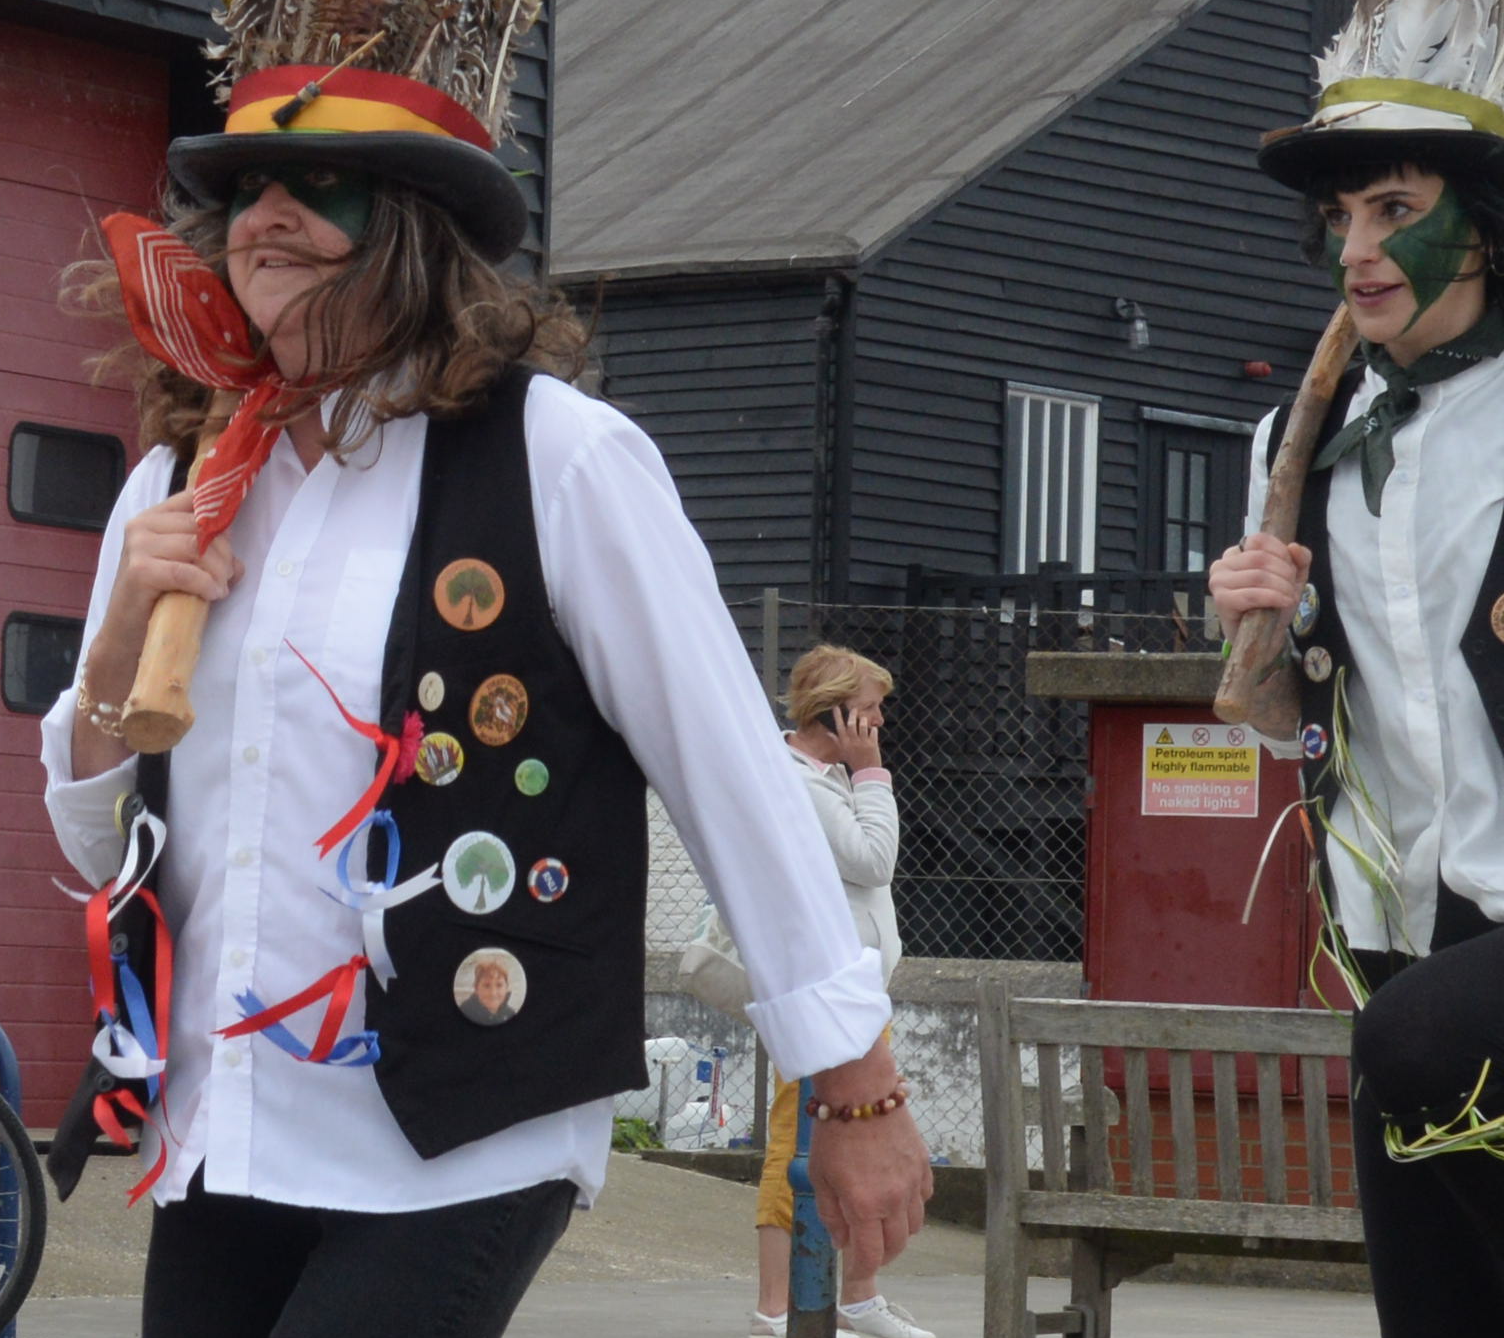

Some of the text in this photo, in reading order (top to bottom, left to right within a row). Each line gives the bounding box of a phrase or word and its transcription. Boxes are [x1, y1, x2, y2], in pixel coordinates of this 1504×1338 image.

[1155, 748, 1247, 762] Petroleum spirit
[1151, 762, 1250, 773] Highly flammable
[1151, 782, 1249, 797] No smoking or
[1159, 796, 1240, 810] naked lights
